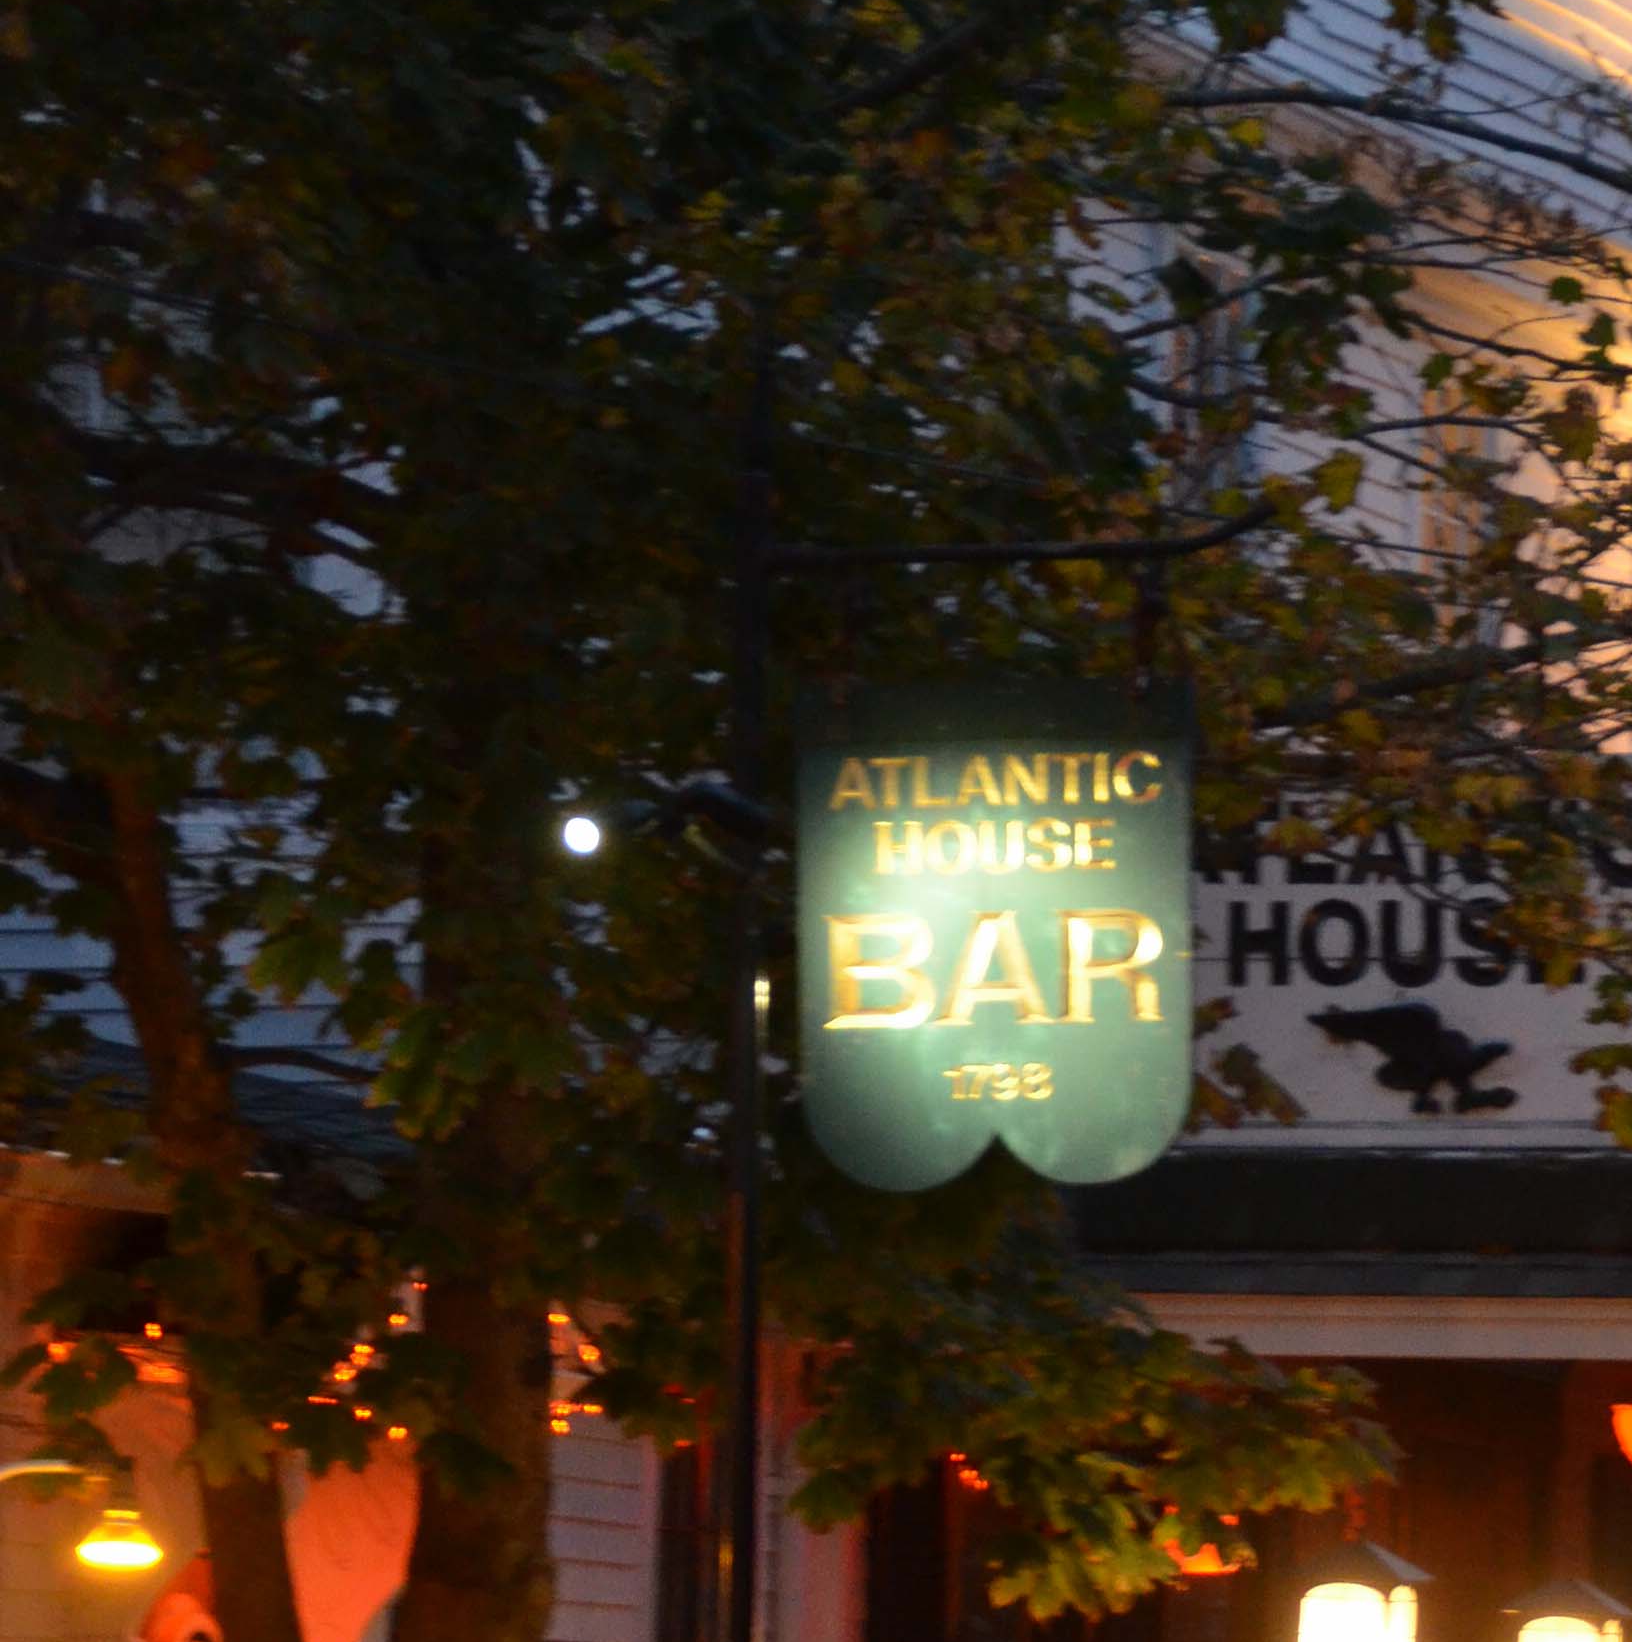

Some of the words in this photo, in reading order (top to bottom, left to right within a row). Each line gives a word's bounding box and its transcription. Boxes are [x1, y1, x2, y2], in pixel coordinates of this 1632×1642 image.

[828, 750, 1162, 811] ATLANTIC
[871, 817, 1118, 876] HOUSE
[822, 907, 1165, 1031] BAR
[1228, 897, 1586, 989] HOUS
